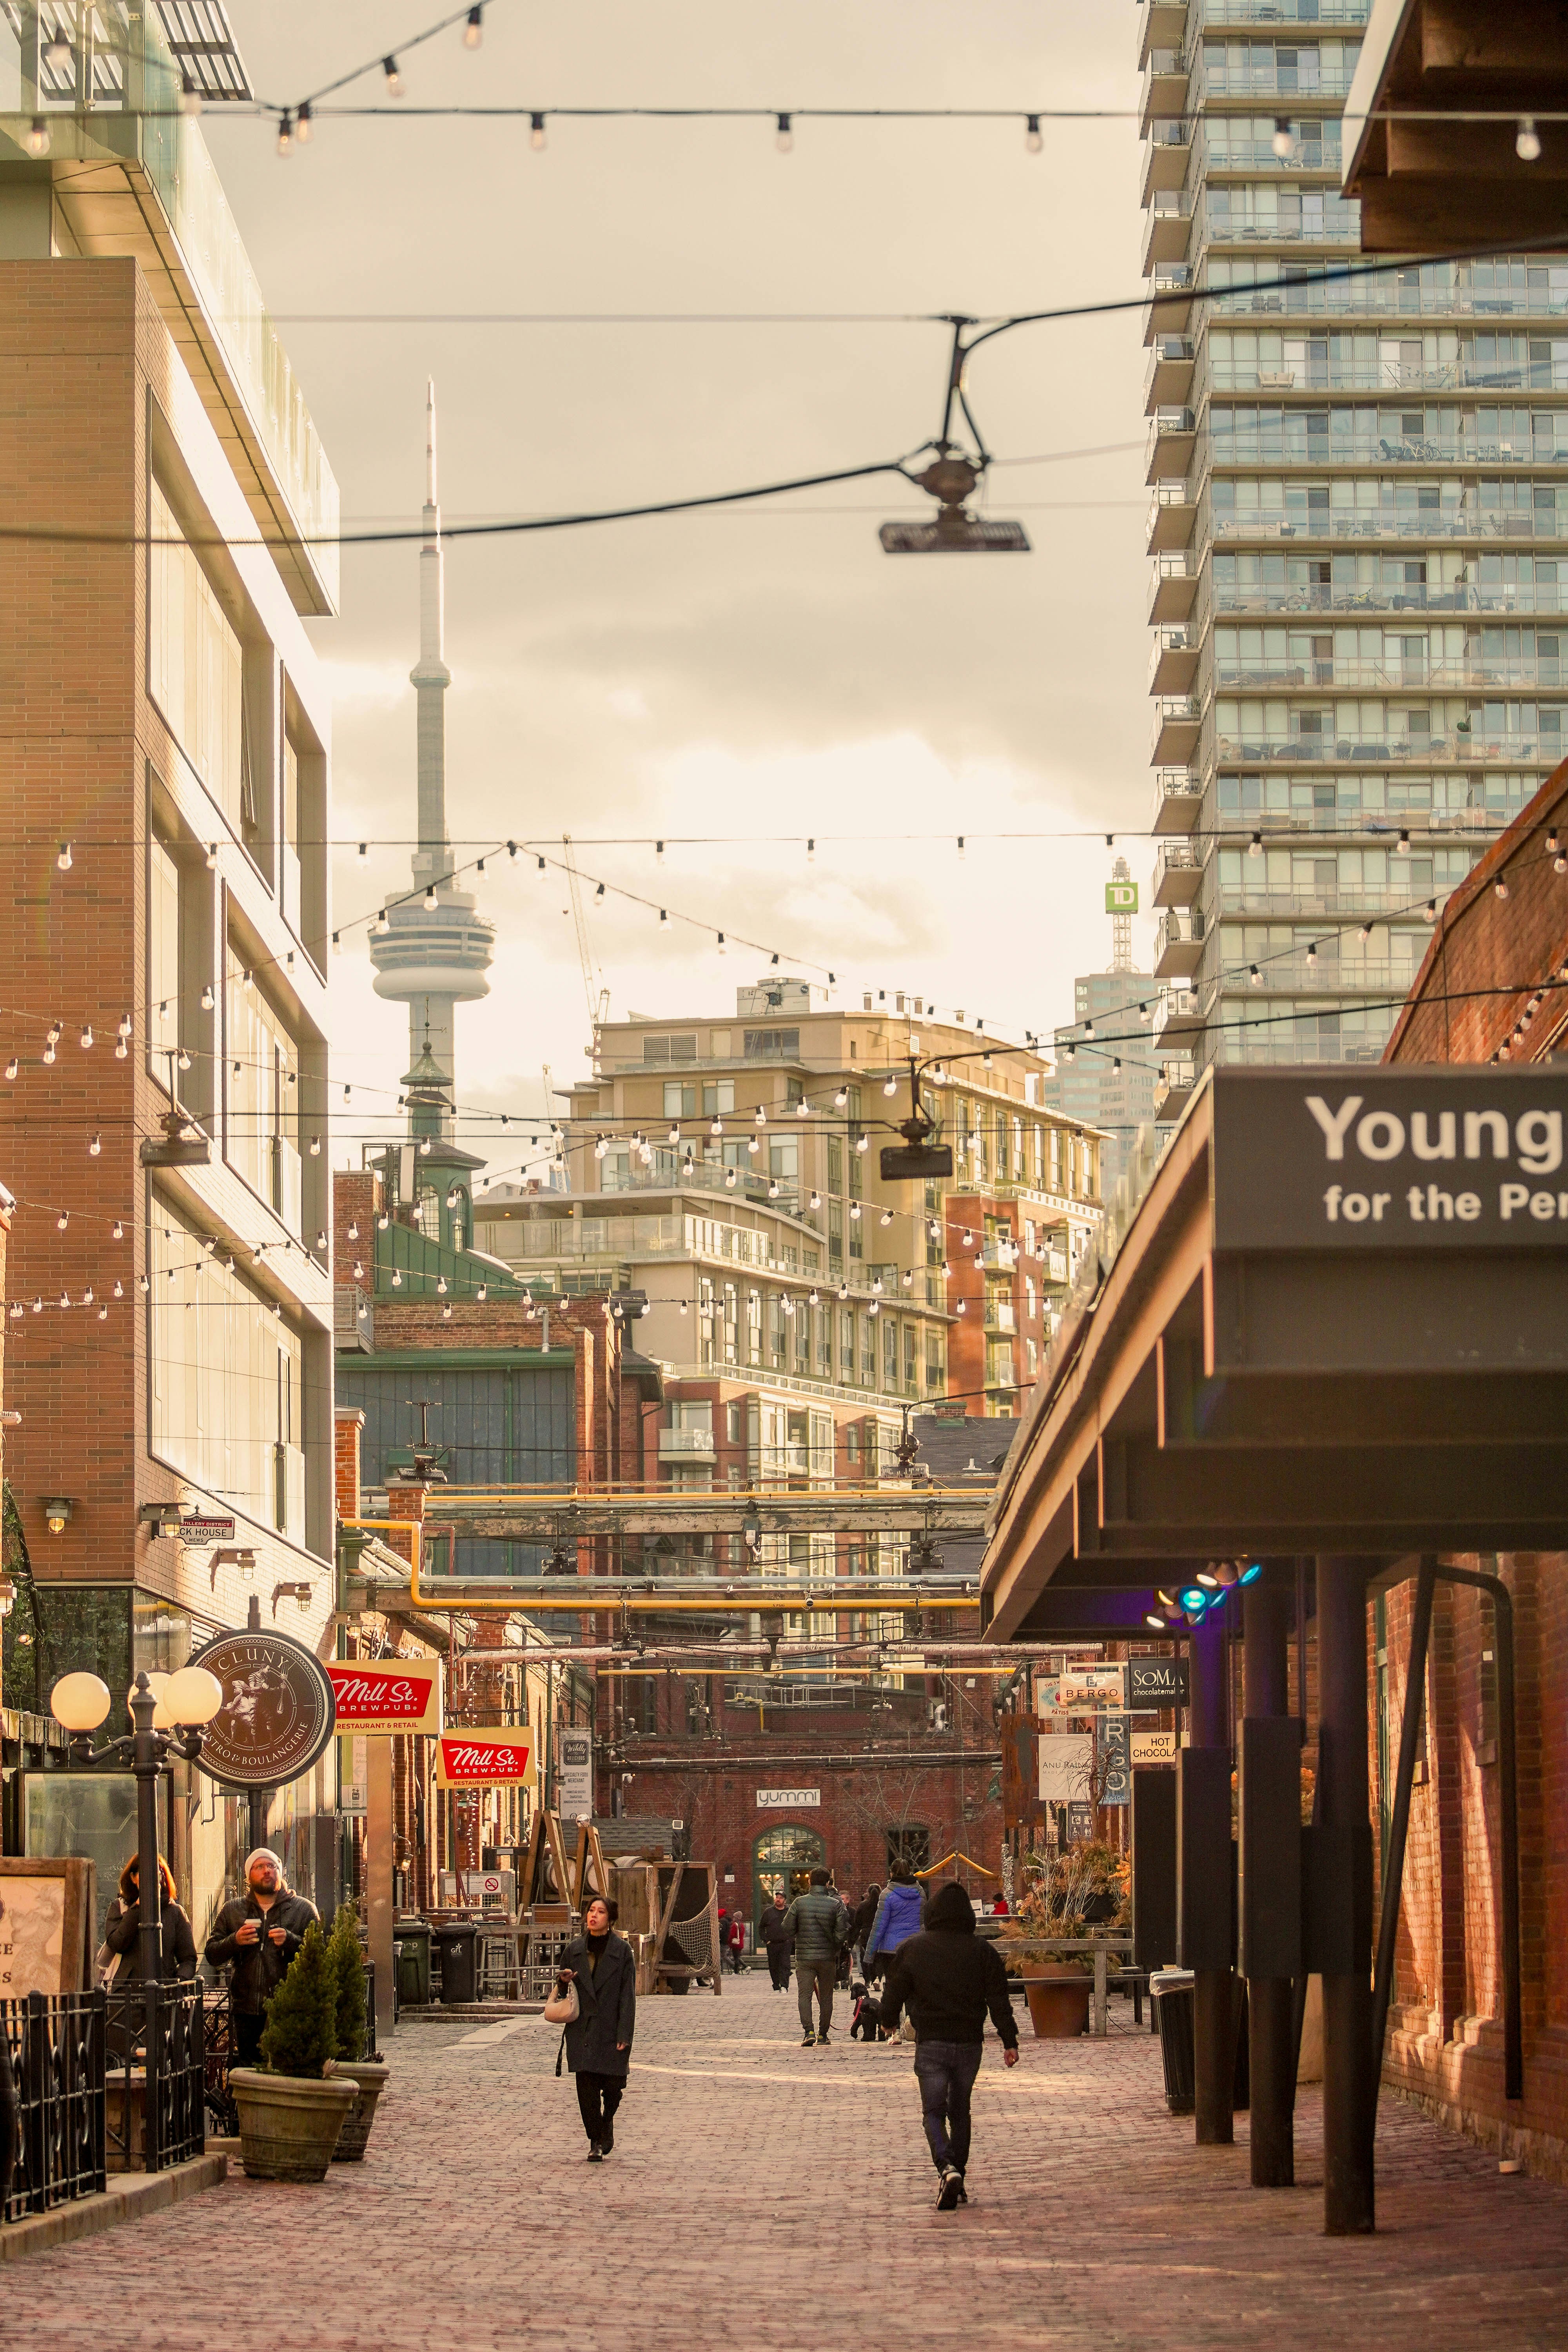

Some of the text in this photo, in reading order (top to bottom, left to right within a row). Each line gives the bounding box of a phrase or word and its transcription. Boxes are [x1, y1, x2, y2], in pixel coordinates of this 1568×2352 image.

[1109, 887, 1135, 904] TD
[1304, 1096, 1563, 1174] Young
[1323, 1185, 1392, 1221] for
[1407, 1184, 1482, 1221] the
[218, 1648, 289, 1670] CLUNY
[332, 1678, 417, 1702] Mill St.
[1066, 1689, 1118, 1698] BERGO
[1133, 1687, 1185, 1696] chocolatemar
[202, 1726, 230, 1758] BISTRO
[242, 1722, 308, 1765] BOULANGERIE
[566, 1743, 586, 1754] Wildly
[1151, 1738, 1170, 1746] HOT
[448, 1747, 518, 1766] Mill St.
[759, 1791, 817, 1806] yummi
